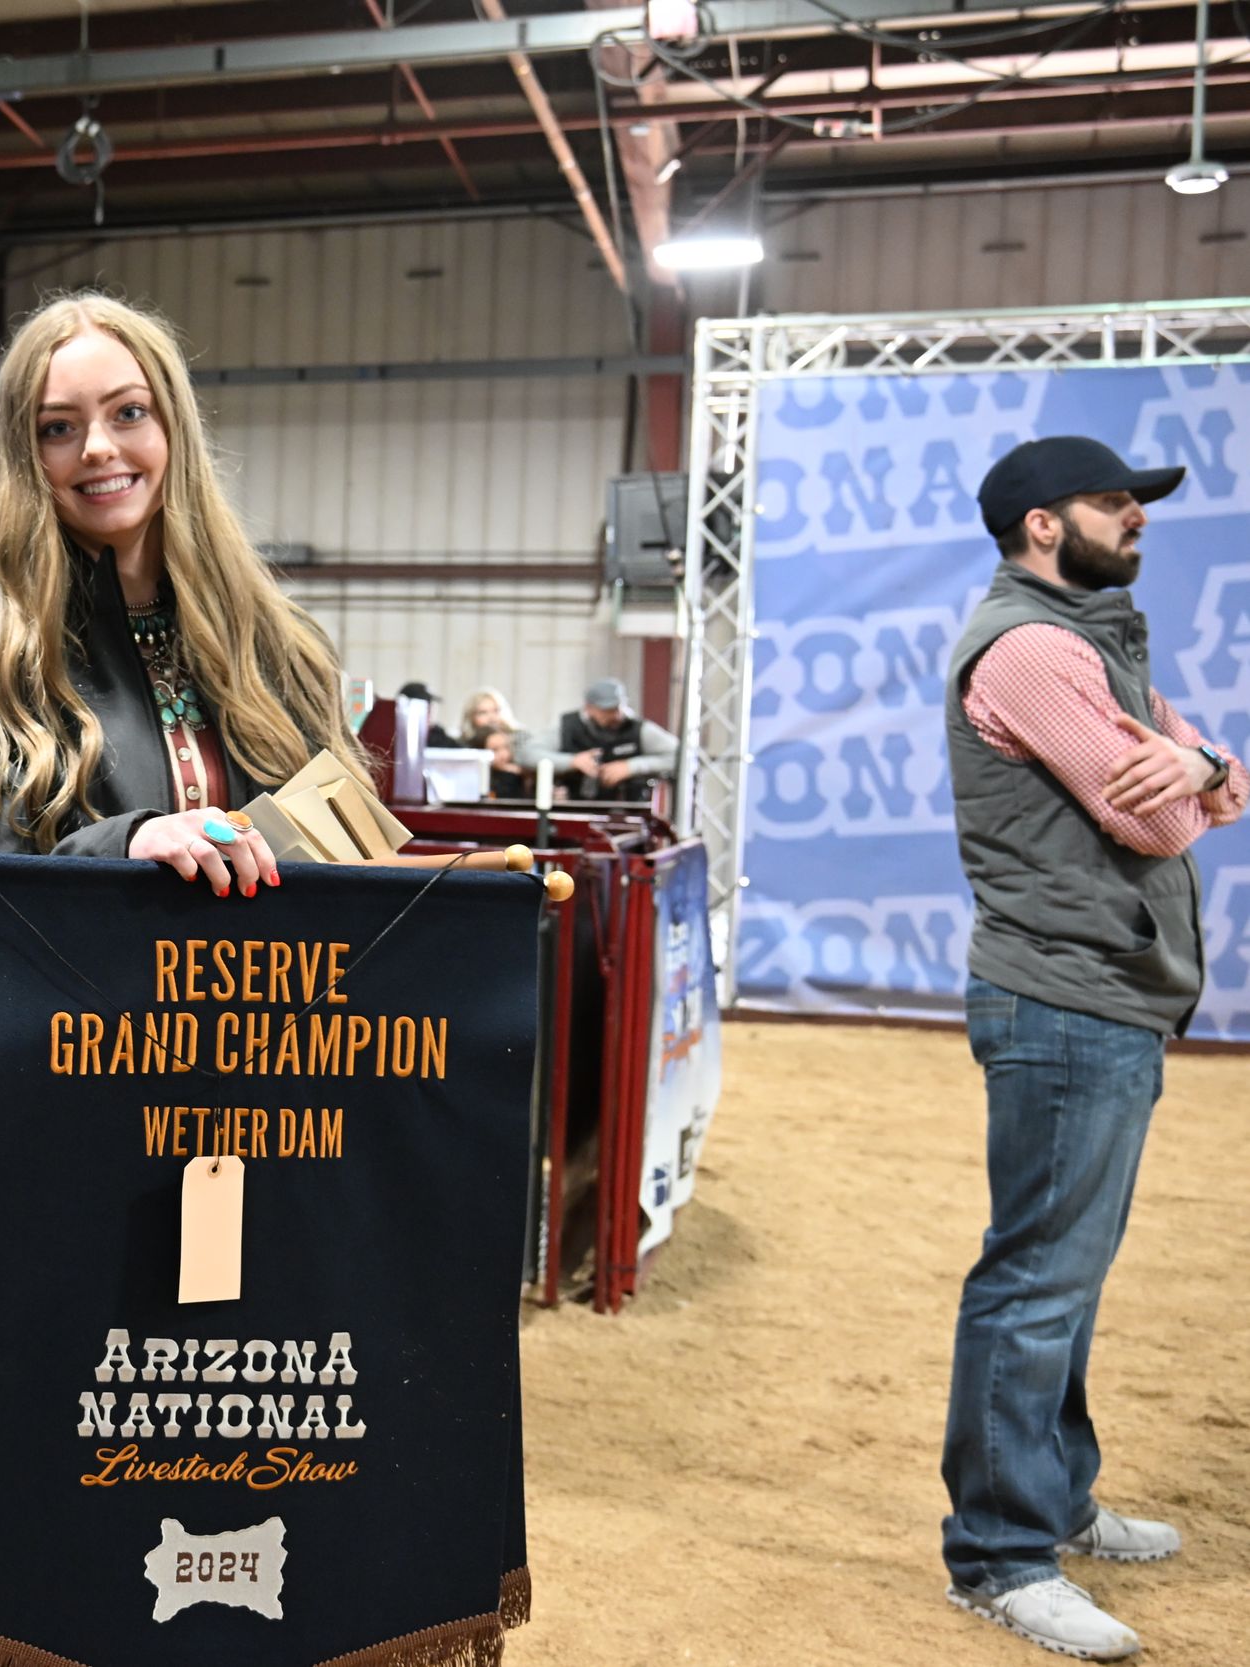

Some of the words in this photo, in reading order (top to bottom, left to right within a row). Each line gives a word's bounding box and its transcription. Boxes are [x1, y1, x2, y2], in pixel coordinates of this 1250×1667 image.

[155, 939, 350, 1004] RESERVE
[50, 1011, 198, 1076] GRAND
[216, 1011, 448, 1080] CHAMPION
[143, 1106, 268, 1158] WETHER
[279, 1107, 343, 1159] DAM
[94, 1328, 358, 1385] ARIZONA
[77, 1391, 367, 1439] NATIONAL
[80, 1443, 248, 1487] Livestock
[246, 1446, 358, 1490] Show
[176, 1551, 260, 1583] 2024
